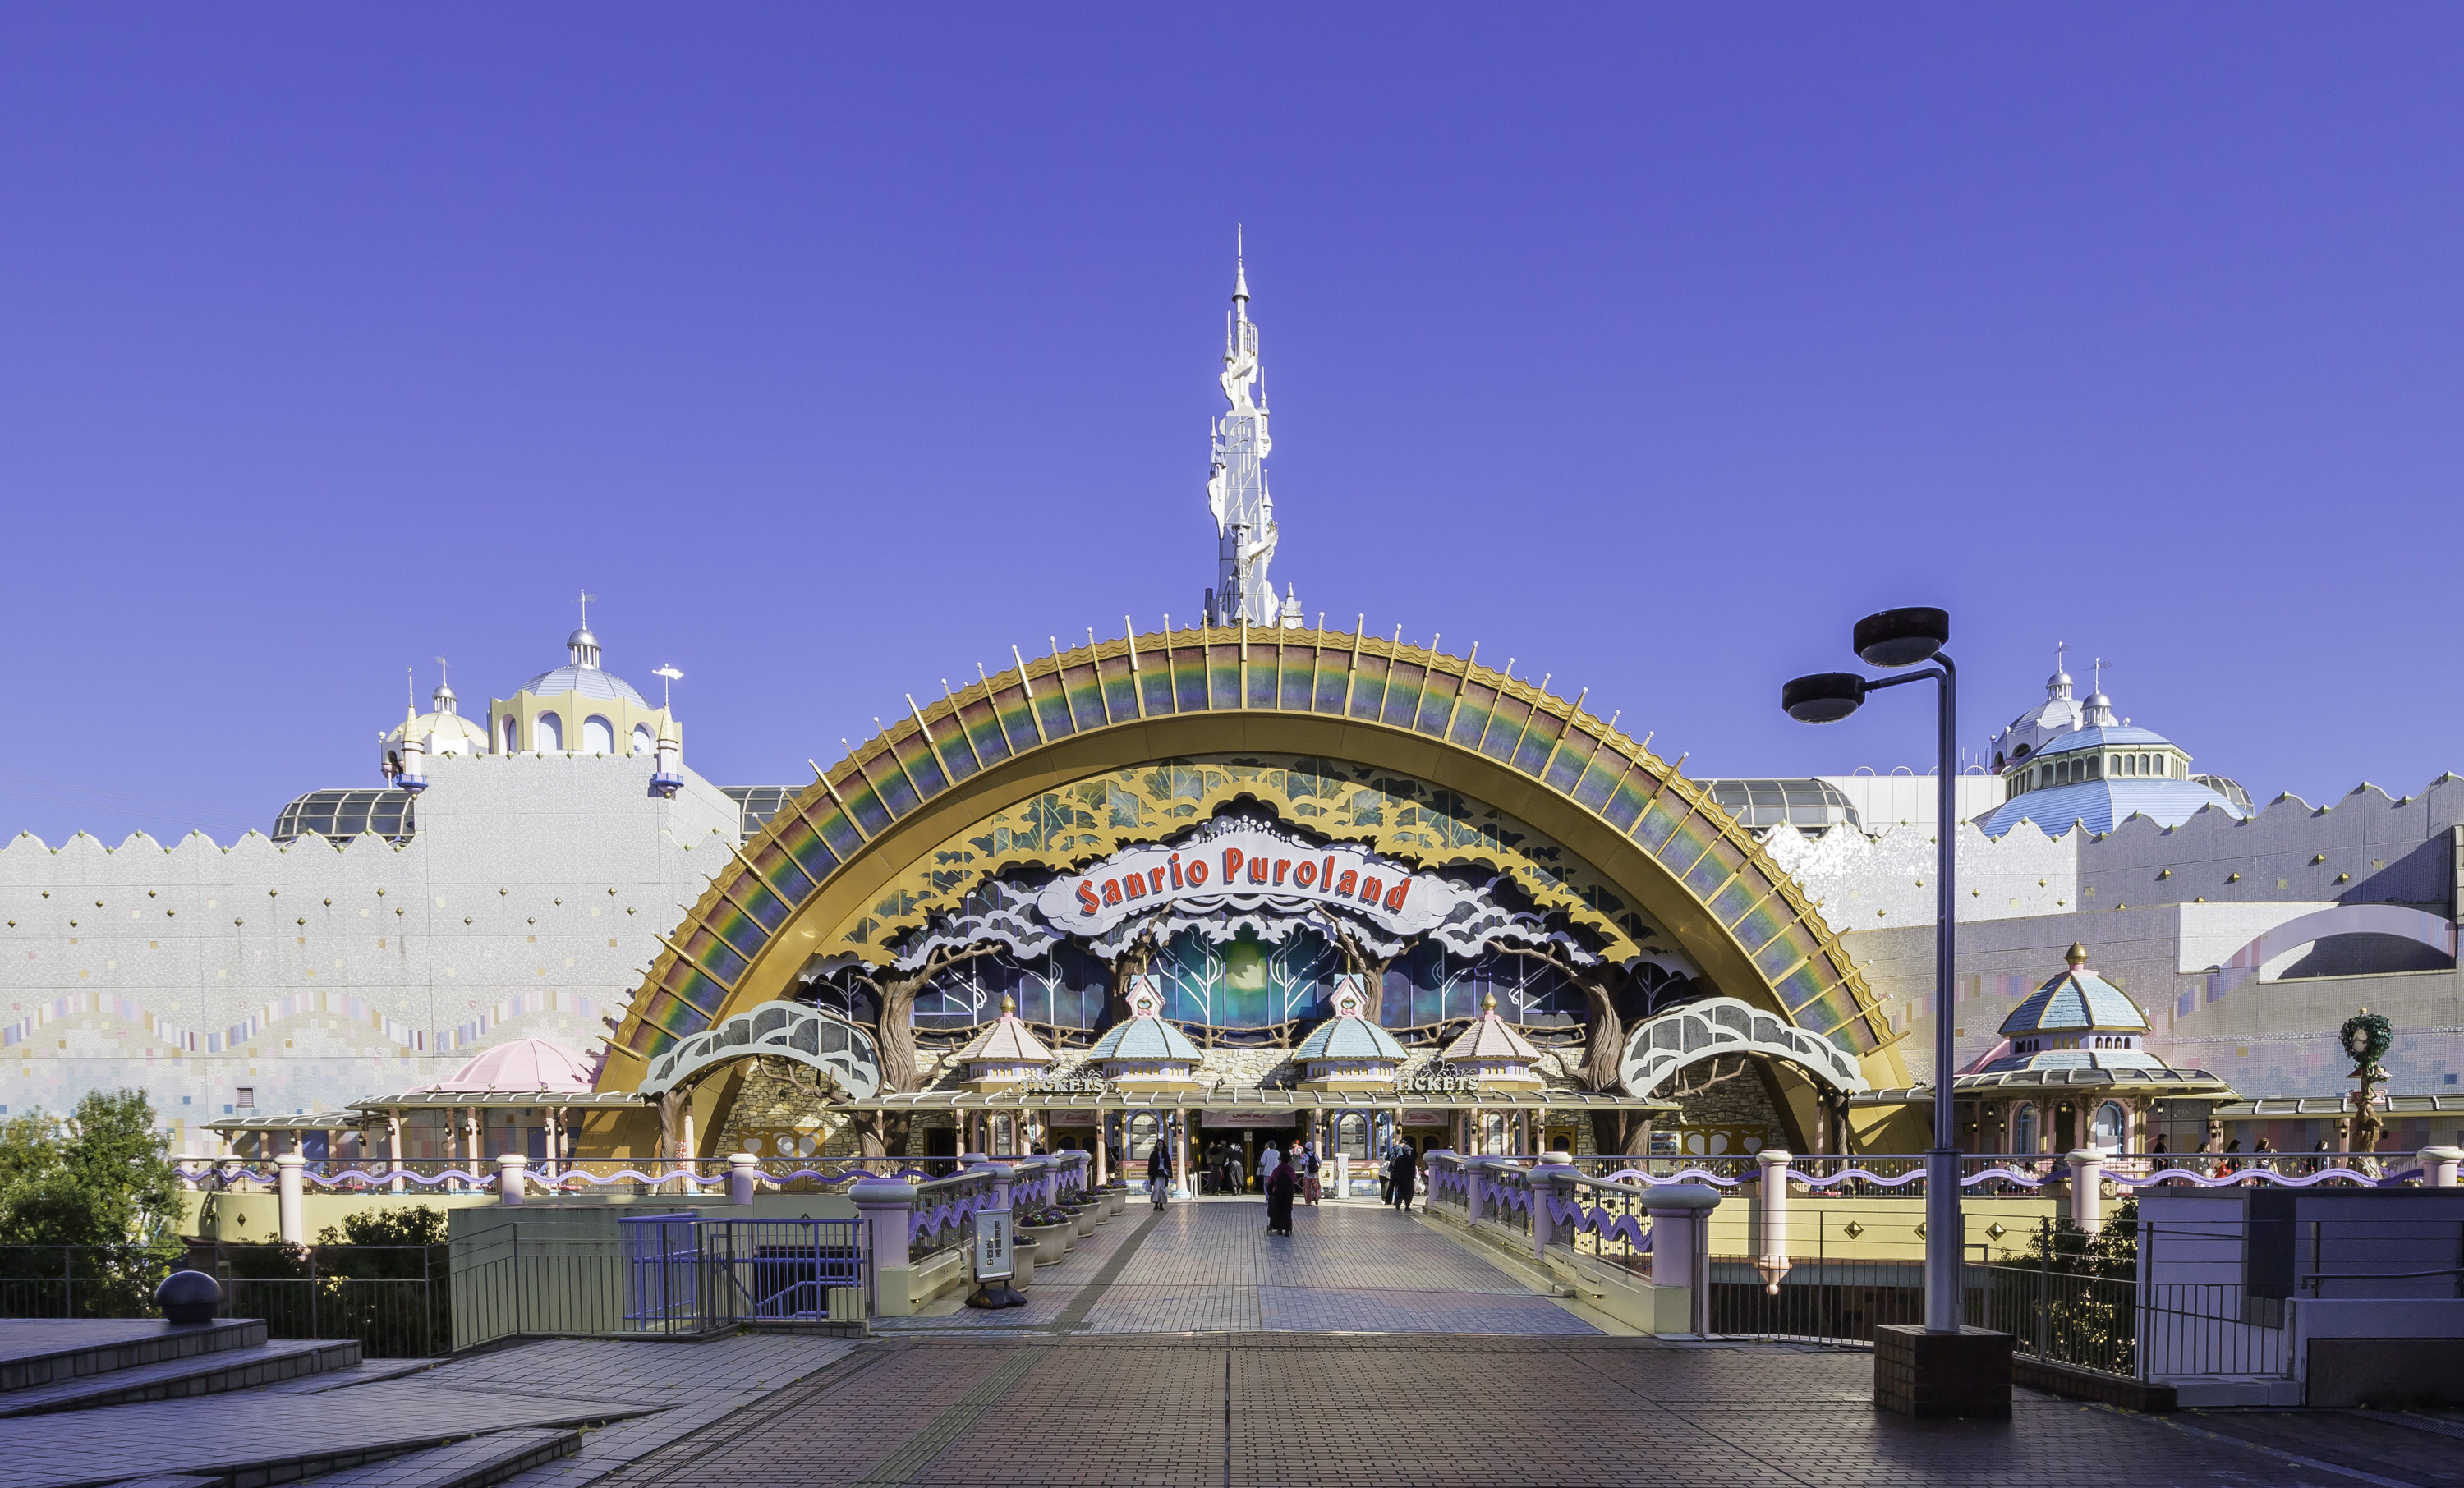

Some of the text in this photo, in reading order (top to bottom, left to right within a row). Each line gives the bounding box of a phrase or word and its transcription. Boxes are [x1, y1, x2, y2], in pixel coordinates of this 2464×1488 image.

[1076, 847, 1412, 916] Sanrio Puroland
[1021, 1078, 1105, 1092] TICKETS
[1395, 1077, 1479, 1091] TICKETS
